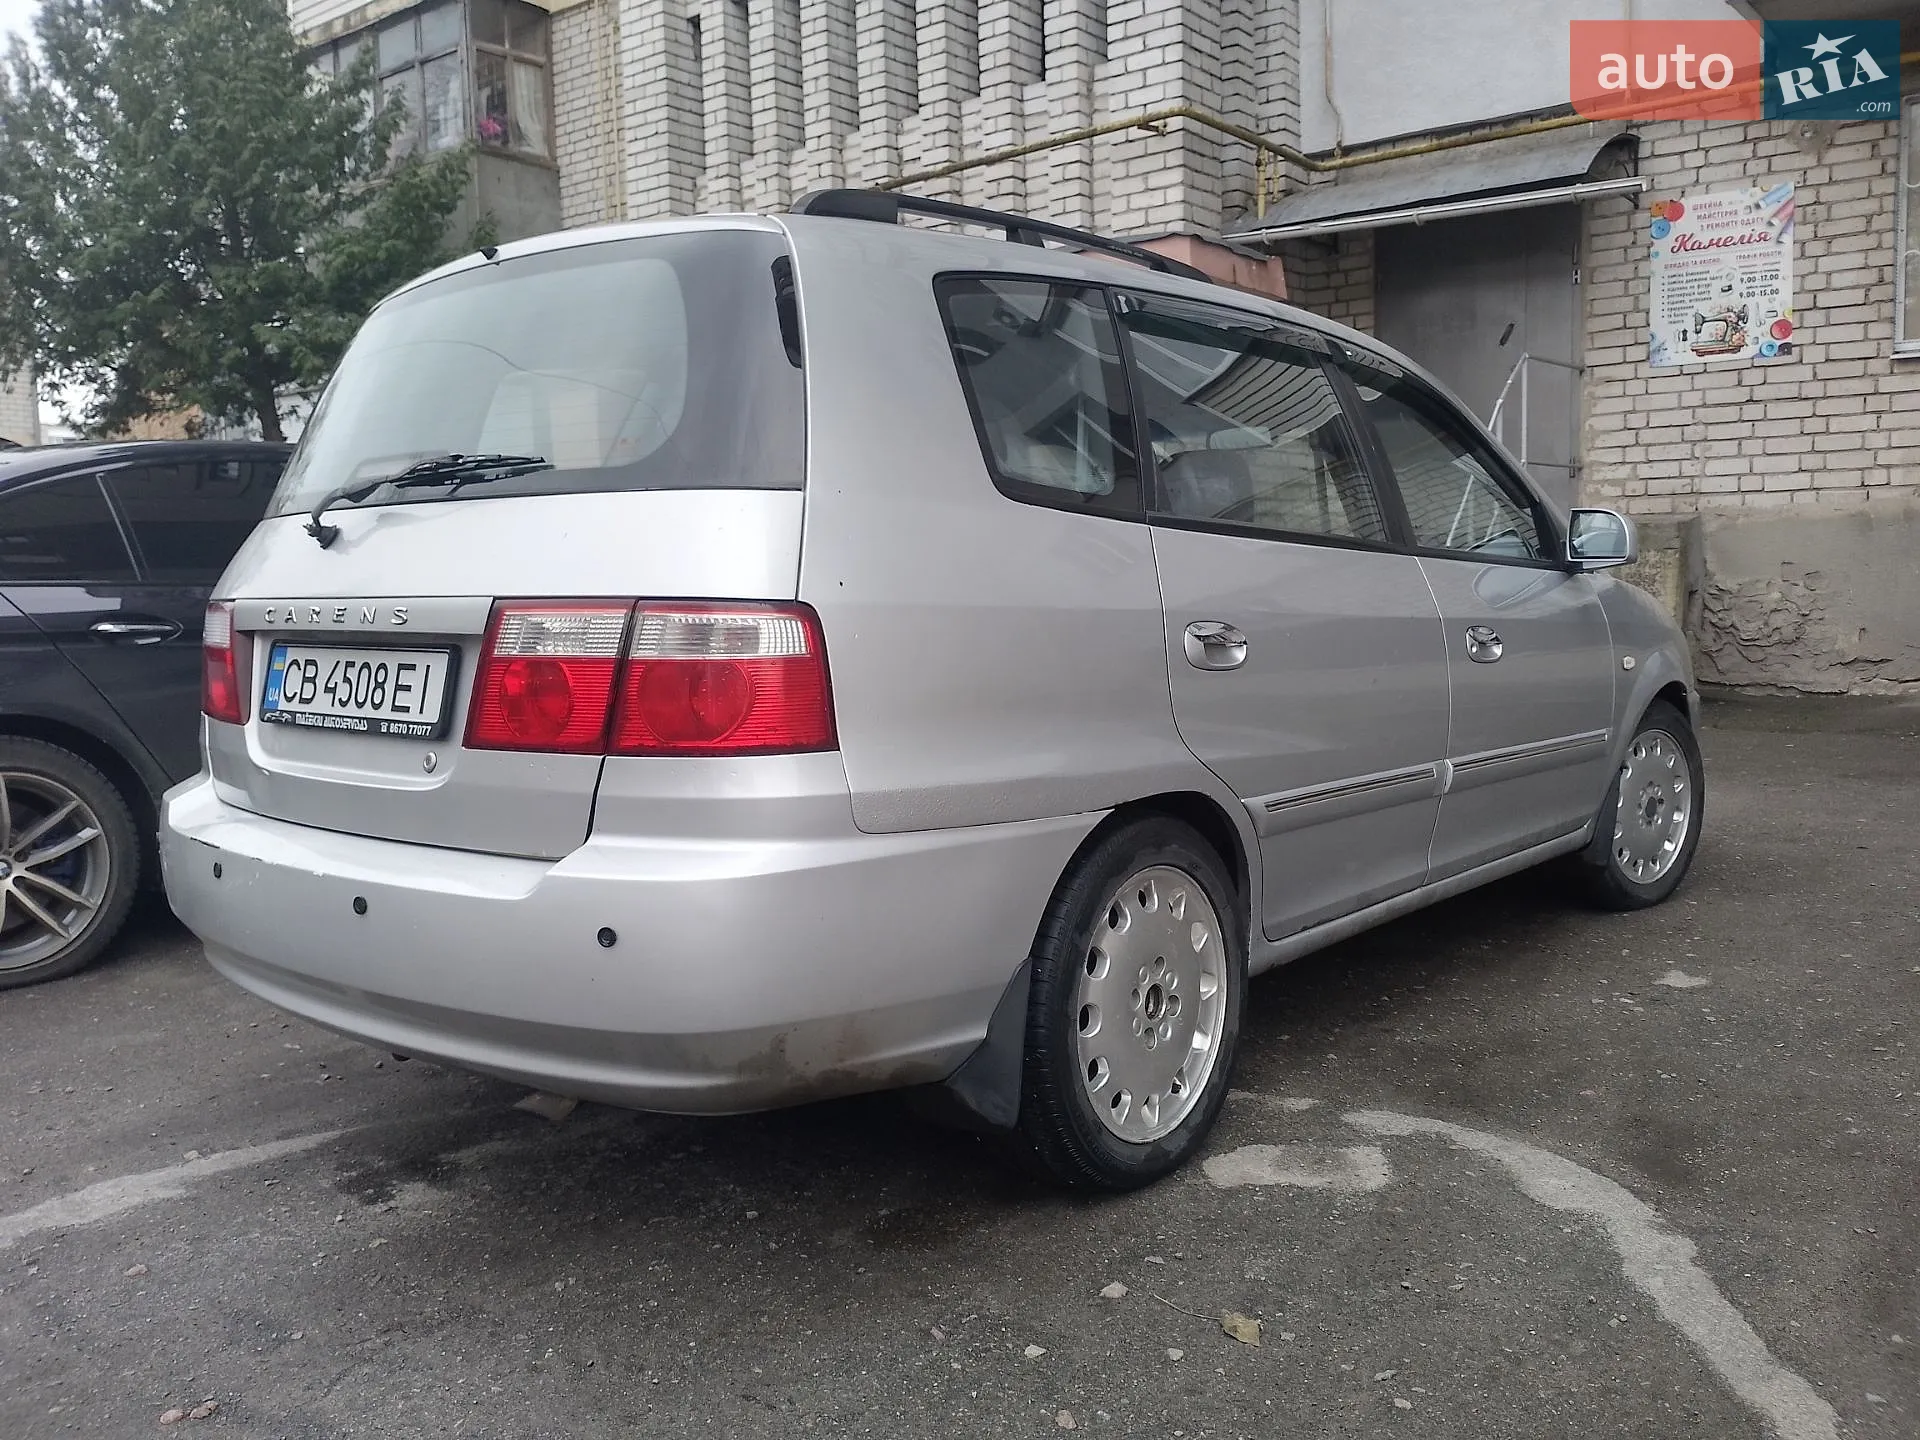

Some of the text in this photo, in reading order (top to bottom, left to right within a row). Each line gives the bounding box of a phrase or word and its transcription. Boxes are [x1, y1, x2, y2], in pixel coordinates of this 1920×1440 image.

[1670, 228, 1772, 254] Камелія
[264, 606, 409, 625] CARENS
[269, 688, 280, 702] UA
[283, 658, 431, 714] CB 4508 EI
